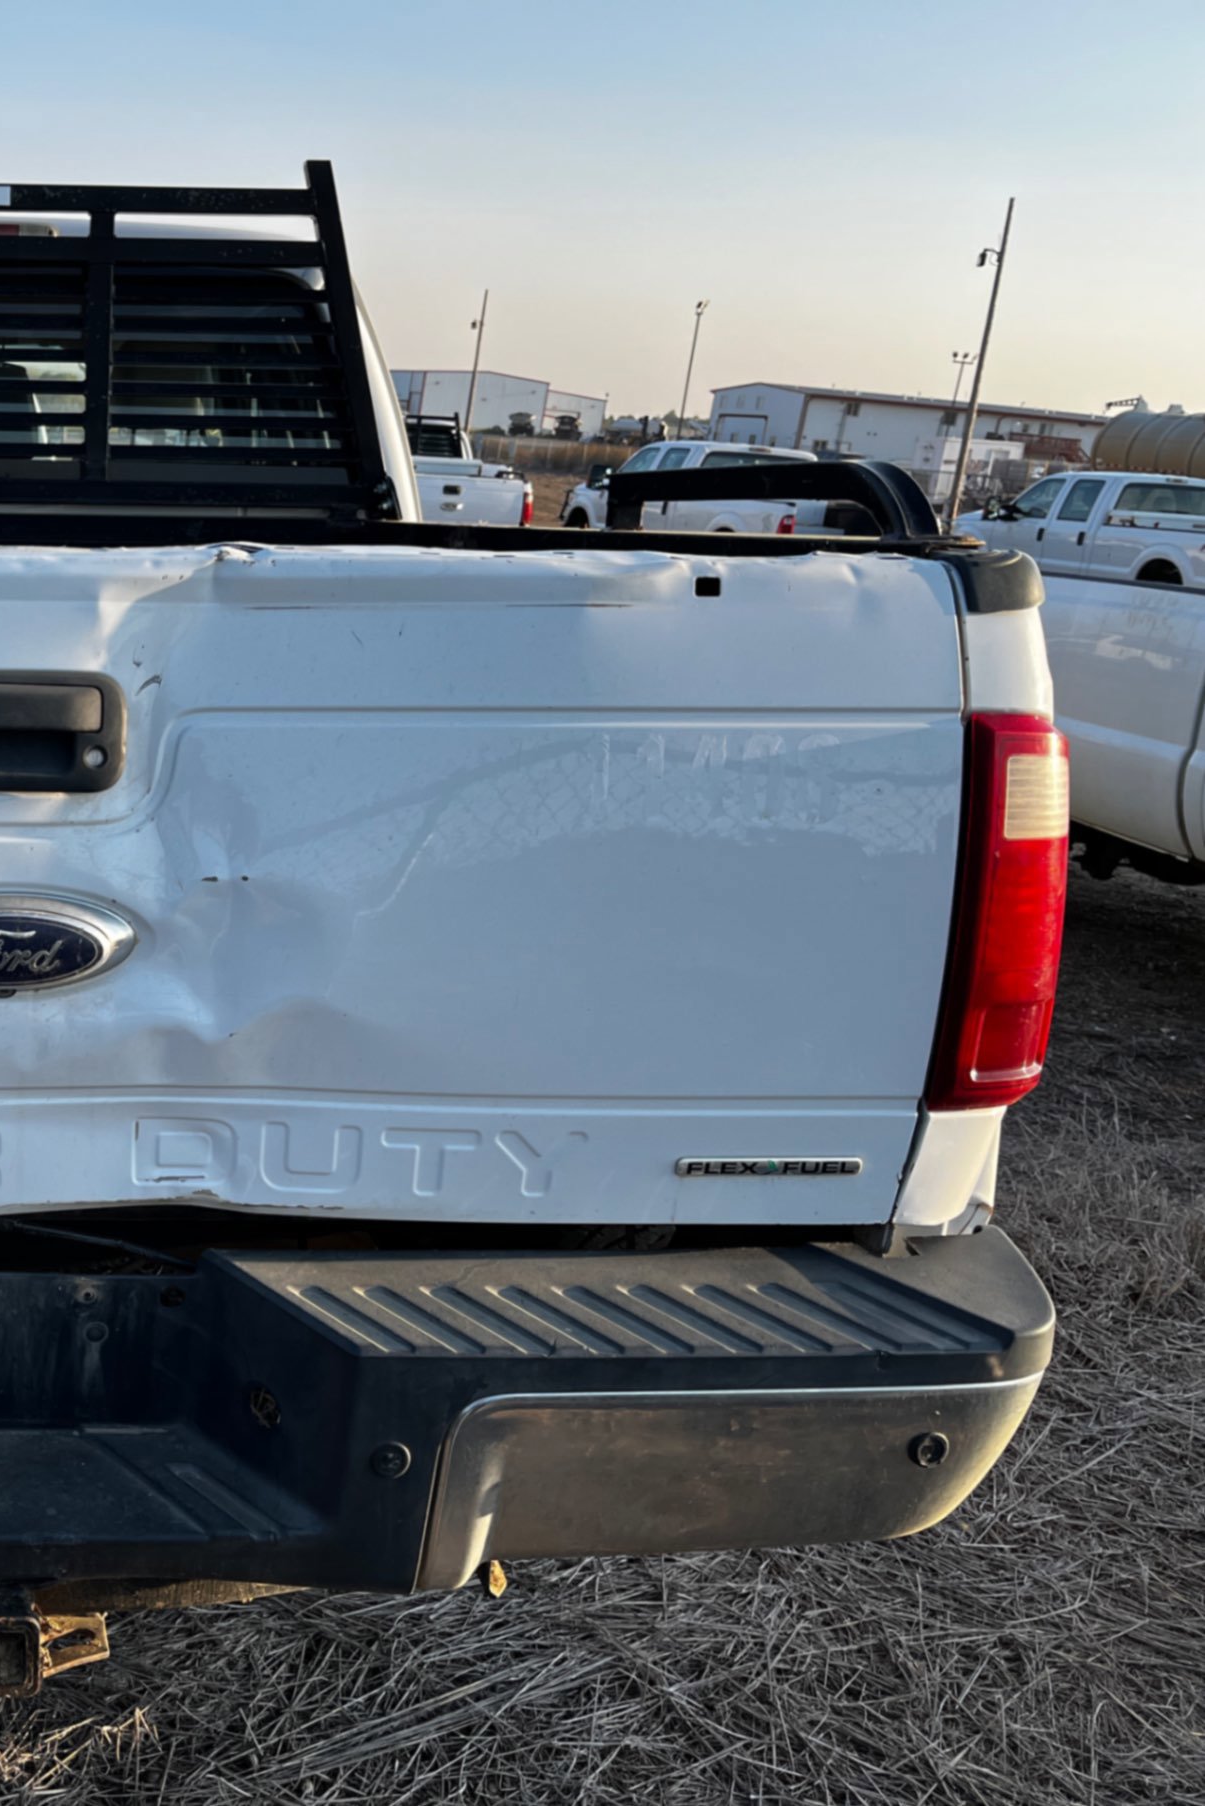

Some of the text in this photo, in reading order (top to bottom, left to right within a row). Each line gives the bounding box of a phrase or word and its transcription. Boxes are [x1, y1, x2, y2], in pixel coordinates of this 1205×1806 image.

[130, 1116, 589, 1197] DUTY
[686, 1160, 856, 1175] FLEX FUEL
